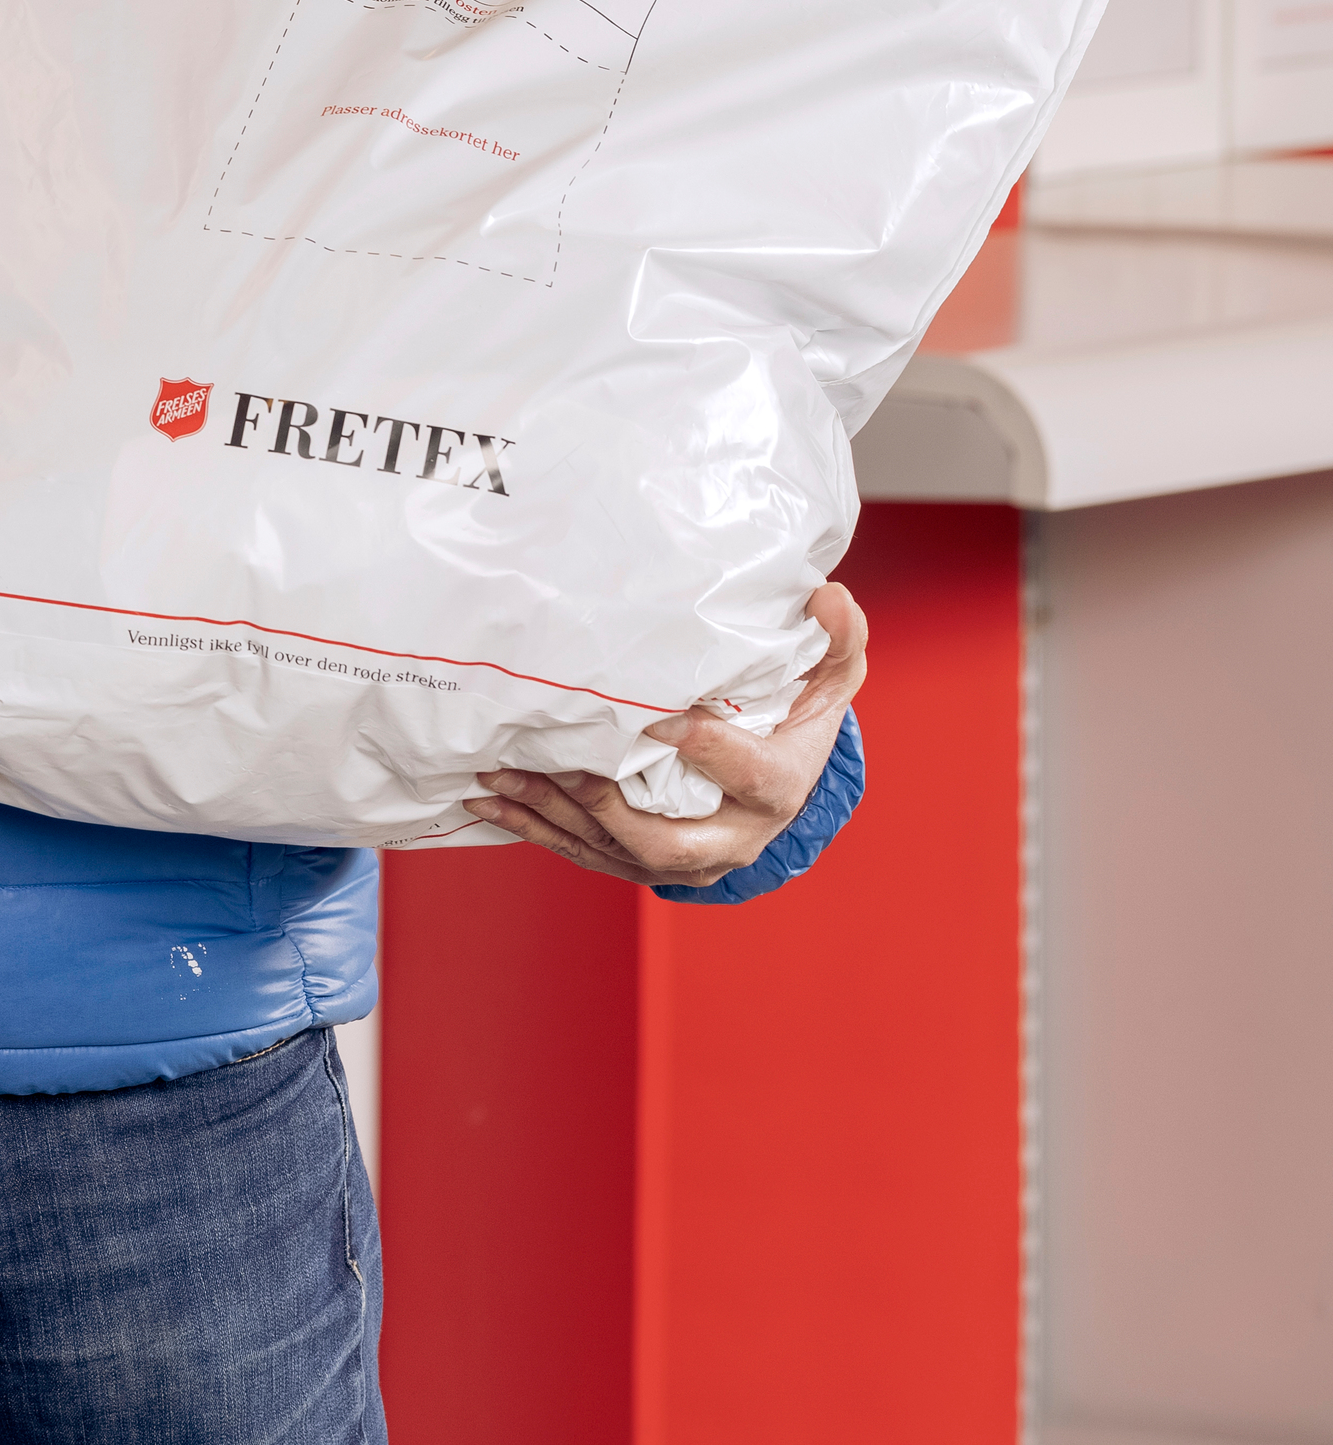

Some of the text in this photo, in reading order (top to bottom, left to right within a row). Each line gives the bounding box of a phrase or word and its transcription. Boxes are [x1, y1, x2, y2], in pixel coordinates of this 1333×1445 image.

[320, 104, 521, 161] Plasser adressekortet her
[156, 401, 203, 427] ARMEEN
[224, 392, 516, 497] FRETEX
[127, 629, 462, 692] Vennligst ikke fyll over den røde streken.
